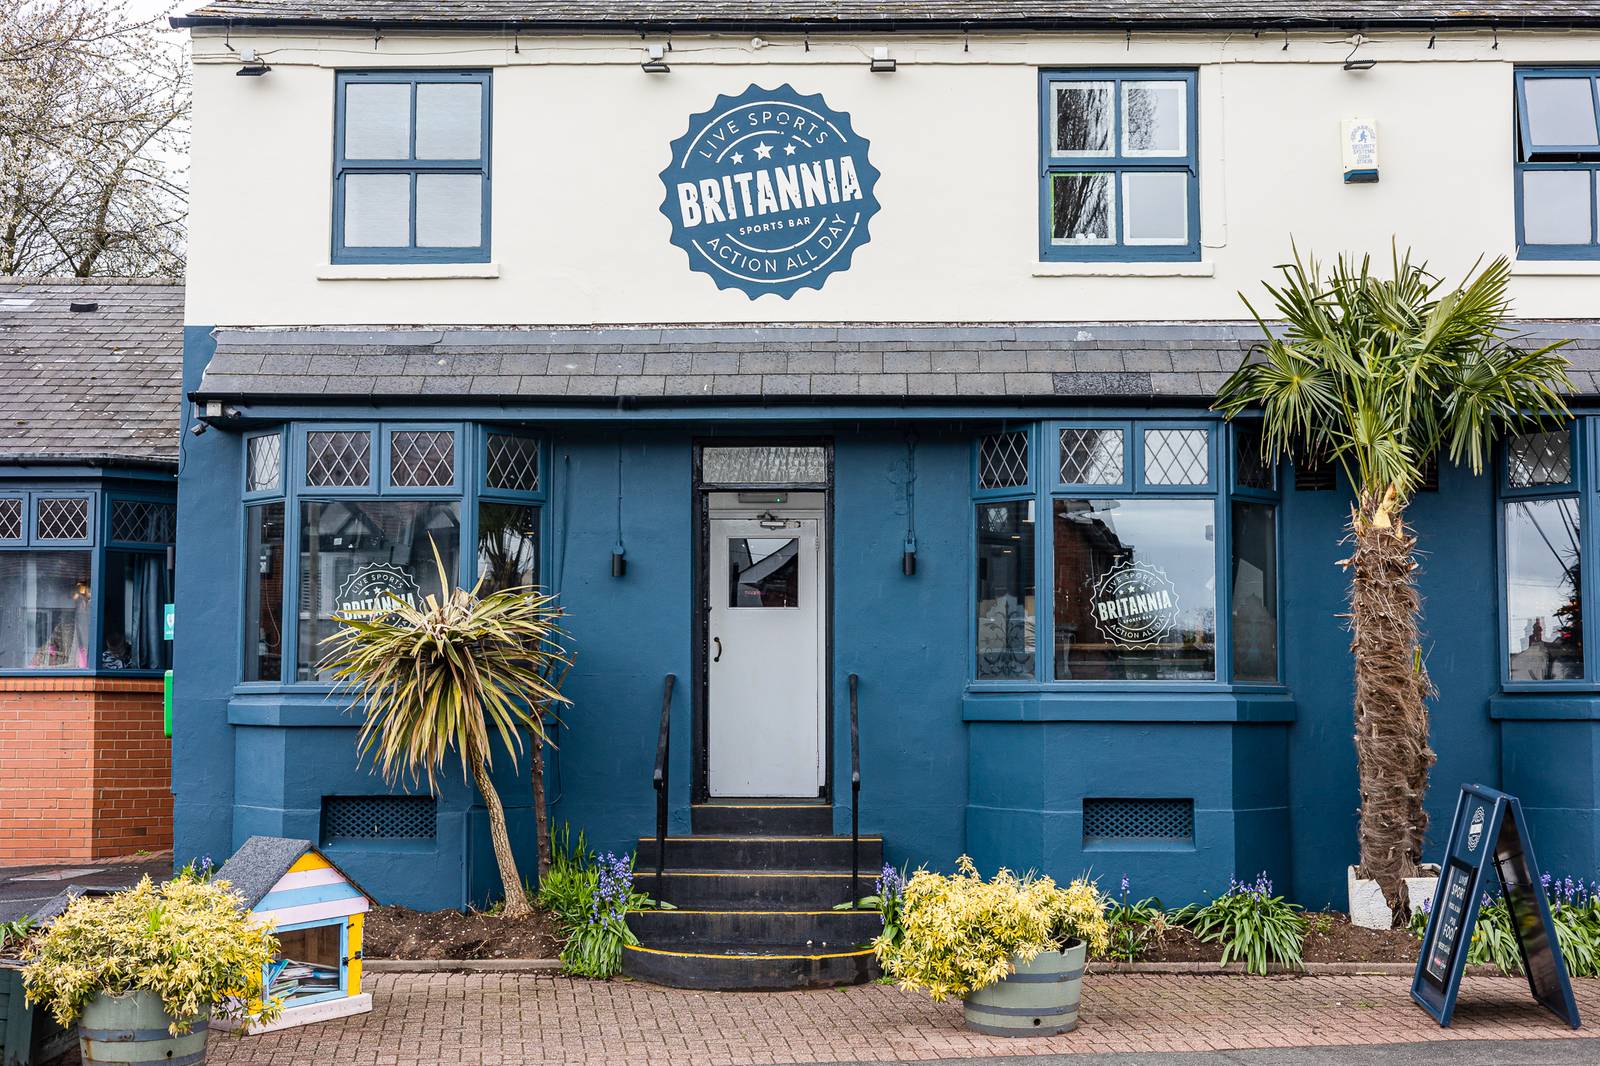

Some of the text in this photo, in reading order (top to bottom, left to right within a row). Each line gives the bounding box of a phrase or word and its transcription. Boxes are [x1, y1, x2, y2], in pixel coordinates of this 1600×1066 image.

[699, 112, 828, 158] LIVE SPORTS
[677, 155, 863, 228] BRITANNIA
[739, 216, 811, 236] SPORTS BAR
[707, 213, 846, 273] ACTION ALL DAY
[352, 574, 404, 594] LIVE SPORTS
[1106, 572, 1156, 593] LIVE SPORTS
[1097, 590, 1172, 621] BRITANNIA
[1110, 614, 1166, 639] ACTION ALL DAY
